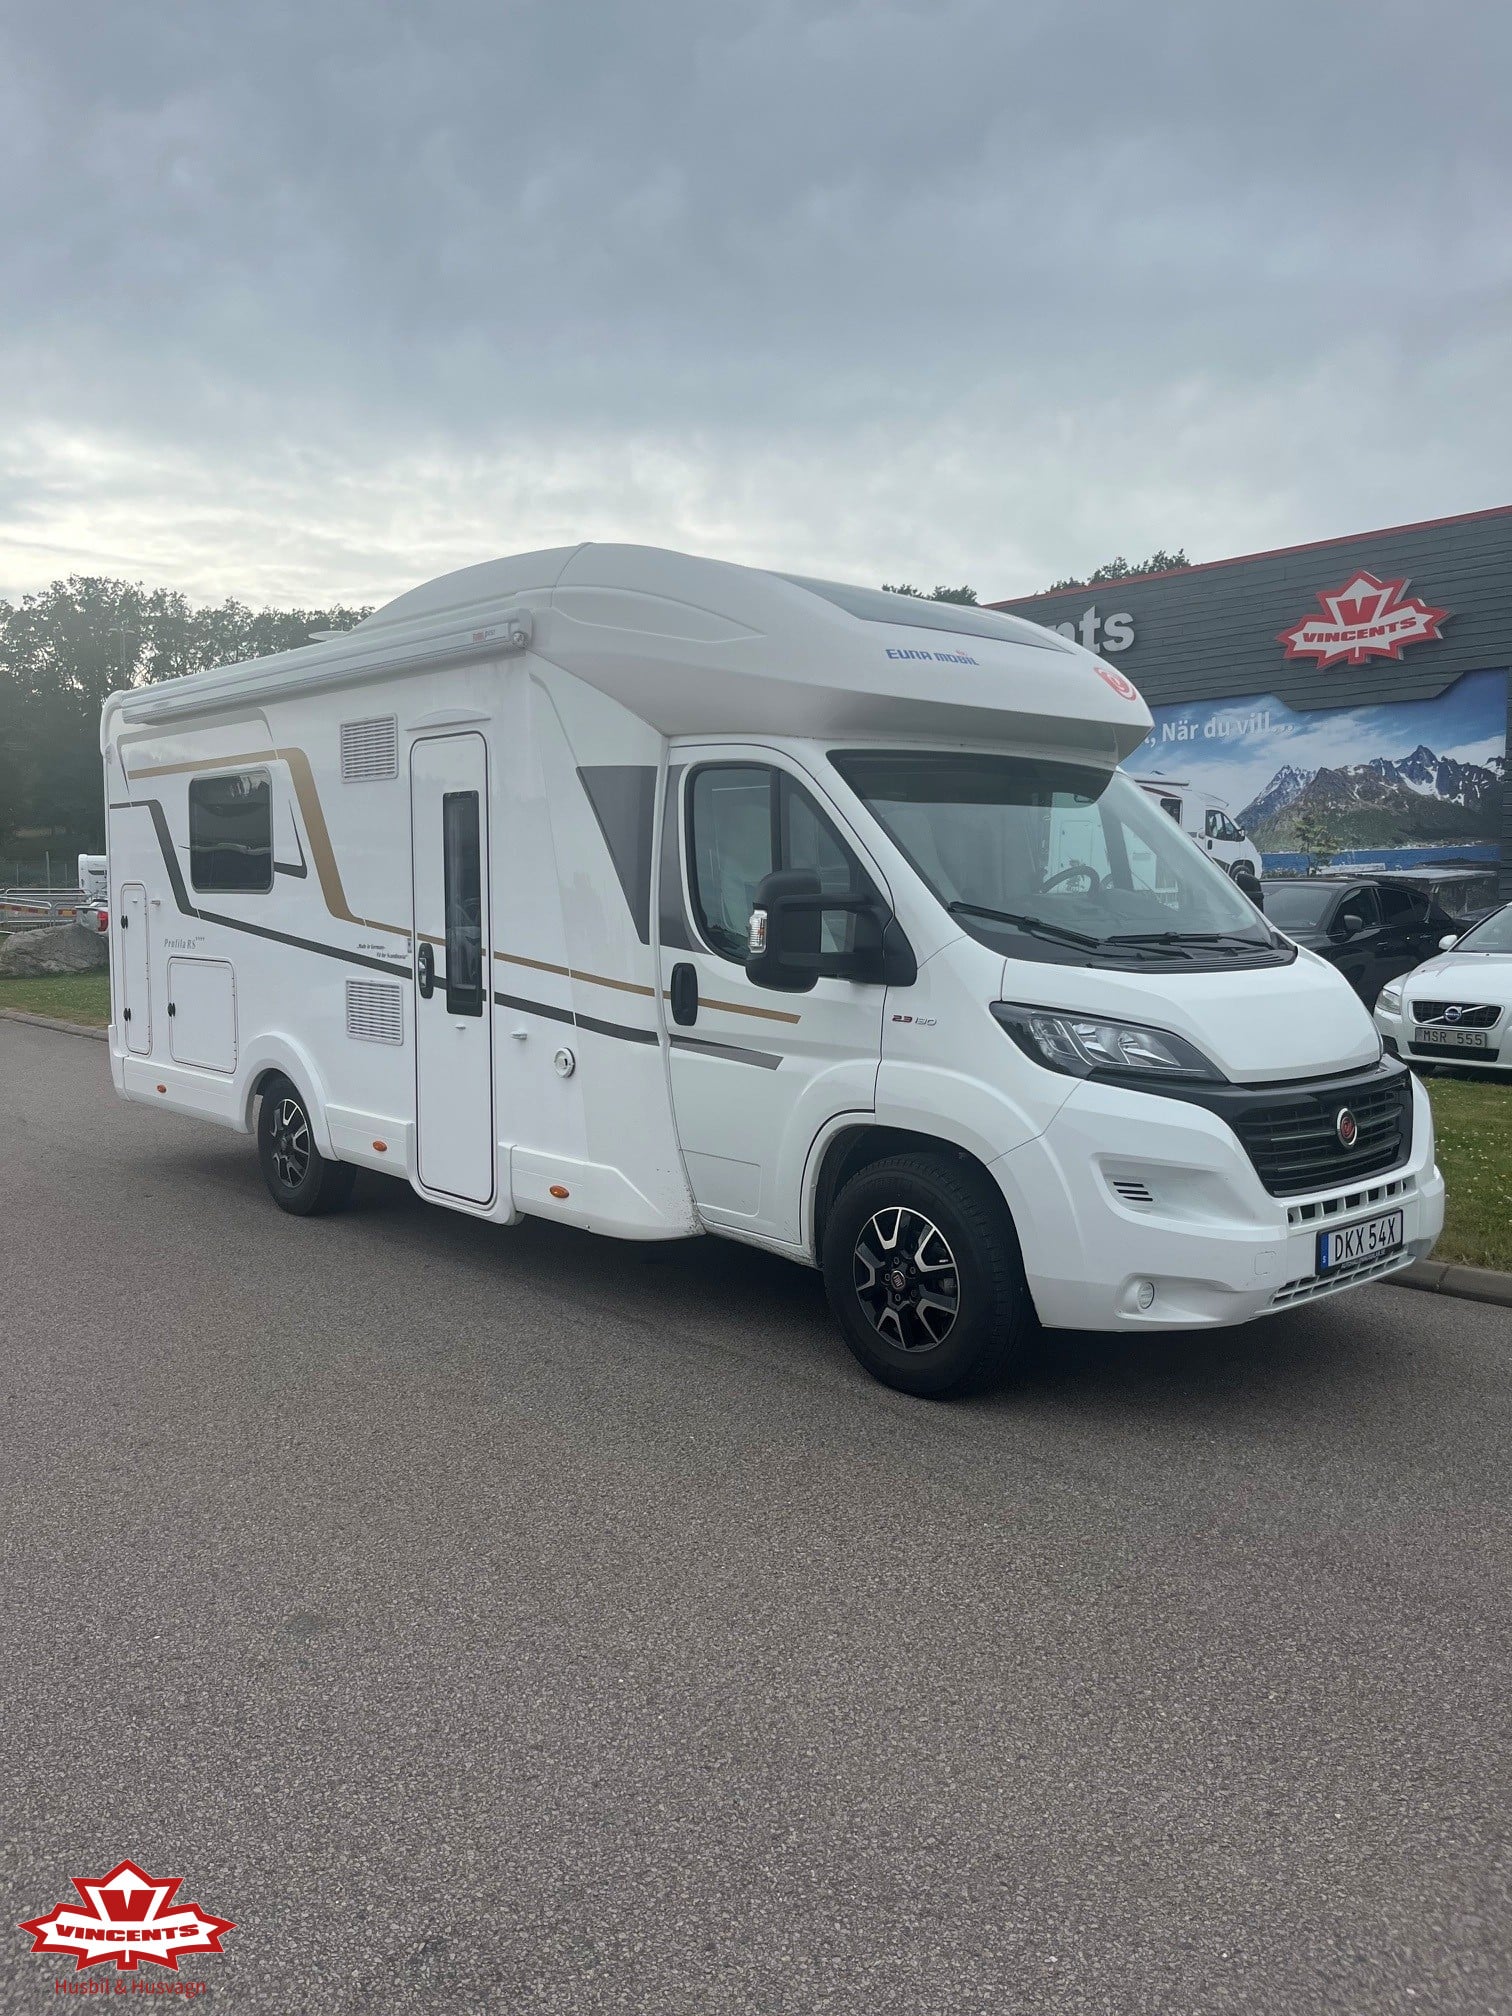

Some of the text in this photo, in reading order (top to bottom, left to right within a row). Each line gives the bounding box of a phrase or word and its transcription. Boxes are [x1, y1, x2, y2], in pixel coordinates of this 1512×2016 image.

[1335, 594, 1383, 627] V
[1302, 617, 1418, 643] VINCENTS
[1162, 719, 1199, 743] När
[1203, 716, 1230, 739] du
[1423, 1030, 1483, 1046] MSR 555
[1334, 1226, 1365, 1262] DKX
[1368, 1217, 1396, 1250] 54X
